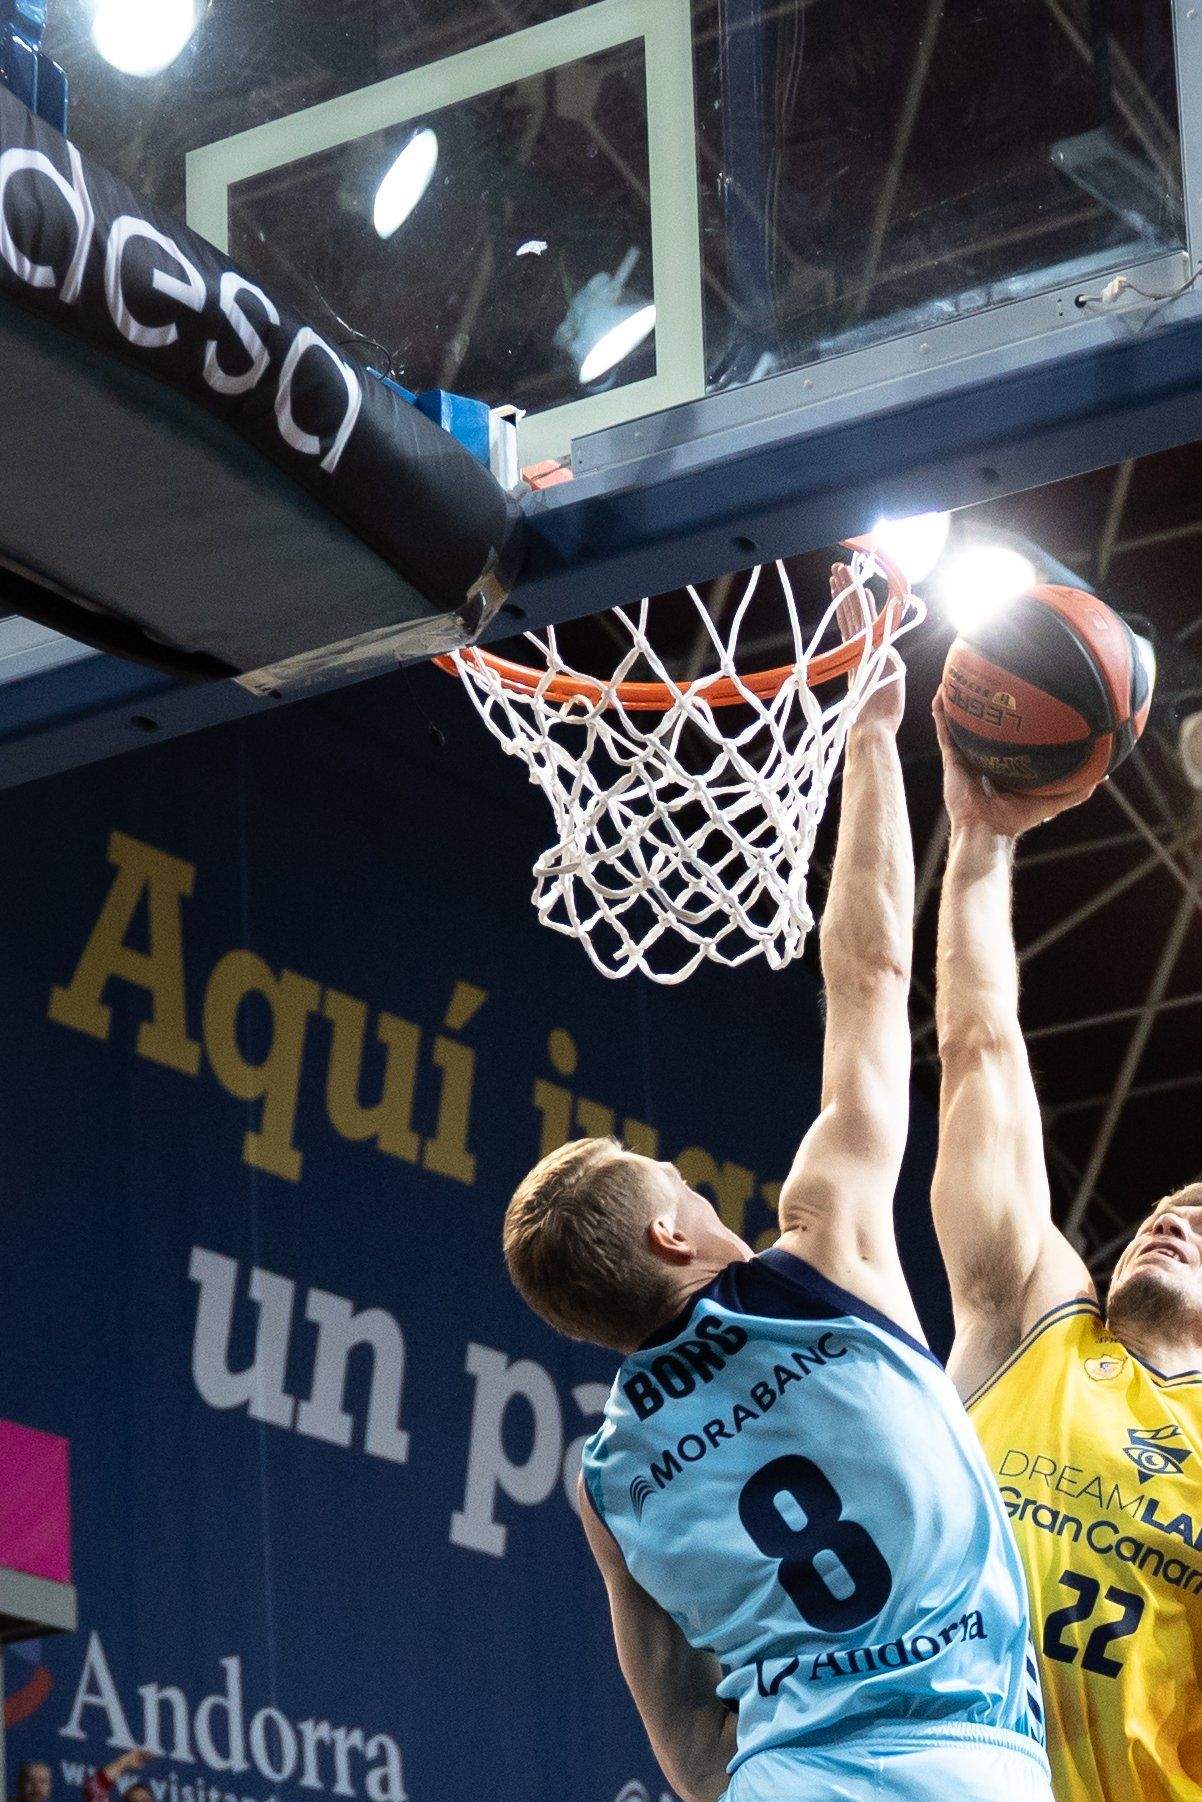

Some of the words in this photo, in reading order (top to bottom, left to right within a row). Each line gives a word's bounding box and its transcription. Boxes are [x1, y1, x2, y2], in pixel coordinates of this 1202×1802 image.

[0, 139, 362, 473] desa
[48, 830, 488, 1187] Aquí
[188, 1246, 409, 1465] un
[650, 1332, 848, 1490] MORABANC
[738, 1454, 892, 1634] 8
[1042, 1569, 1145, 1680] 22
[809, 1609, 988, 1682] Andorra
